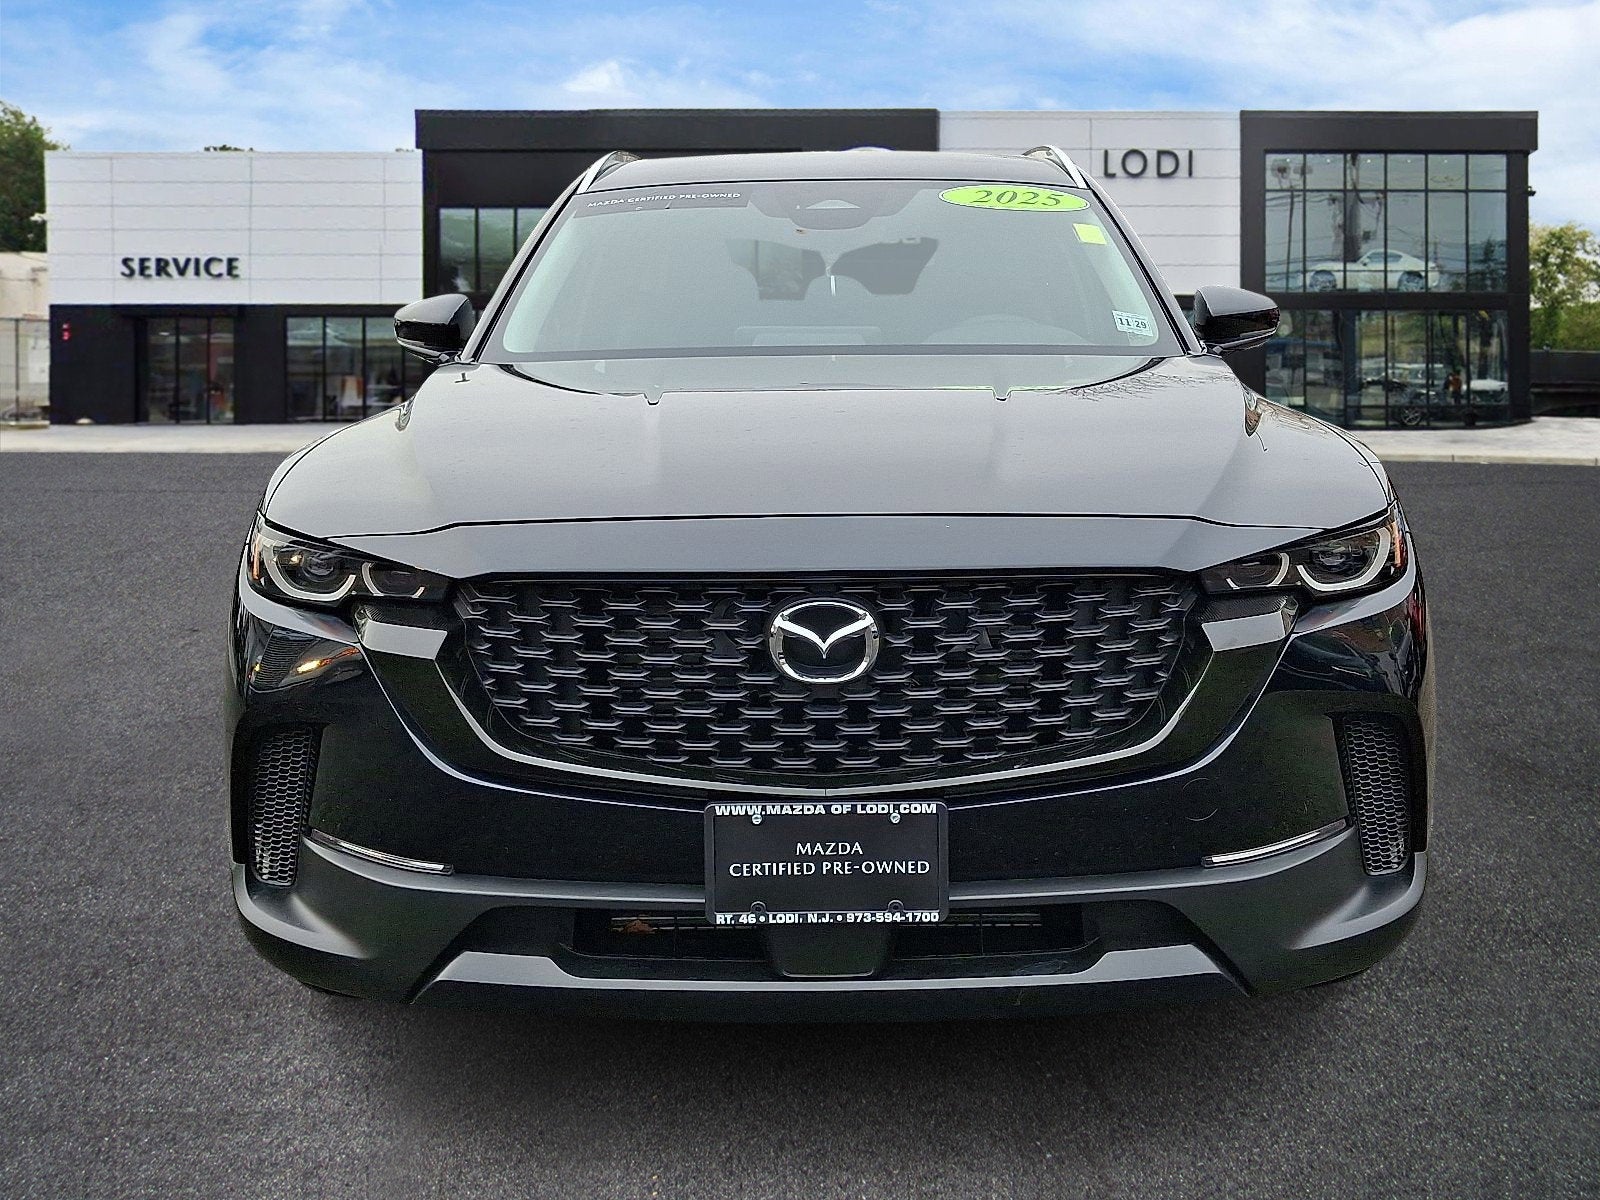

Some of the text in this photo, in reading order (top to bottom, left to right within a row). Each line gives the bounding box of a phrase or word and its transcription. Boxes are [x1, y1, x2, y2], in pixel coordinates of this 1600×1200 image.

[1103, 149, 1193, 178] LODI
[587, 192, 741, 208] MAZDA CERTIFIED PRE-OWNED
[970, 189, 1064, 207] 2025
[120, 256, 240, 278] SERVICE
[1118, 317, 1132, 327] 11
[714, 803, 937, 816] WWW.MAZDA OF LODI.COM
[796, 842, 864, 856] MAZDA
[729, 860, 930, 877] CERTIFIED PRE-OWNED
[715, 914, 735, 925] RT.
[738, 913, 757, 924] 46
[807, 913, 834, 924] N.J.
[846, 912, 940, 923] 973-594-1700
